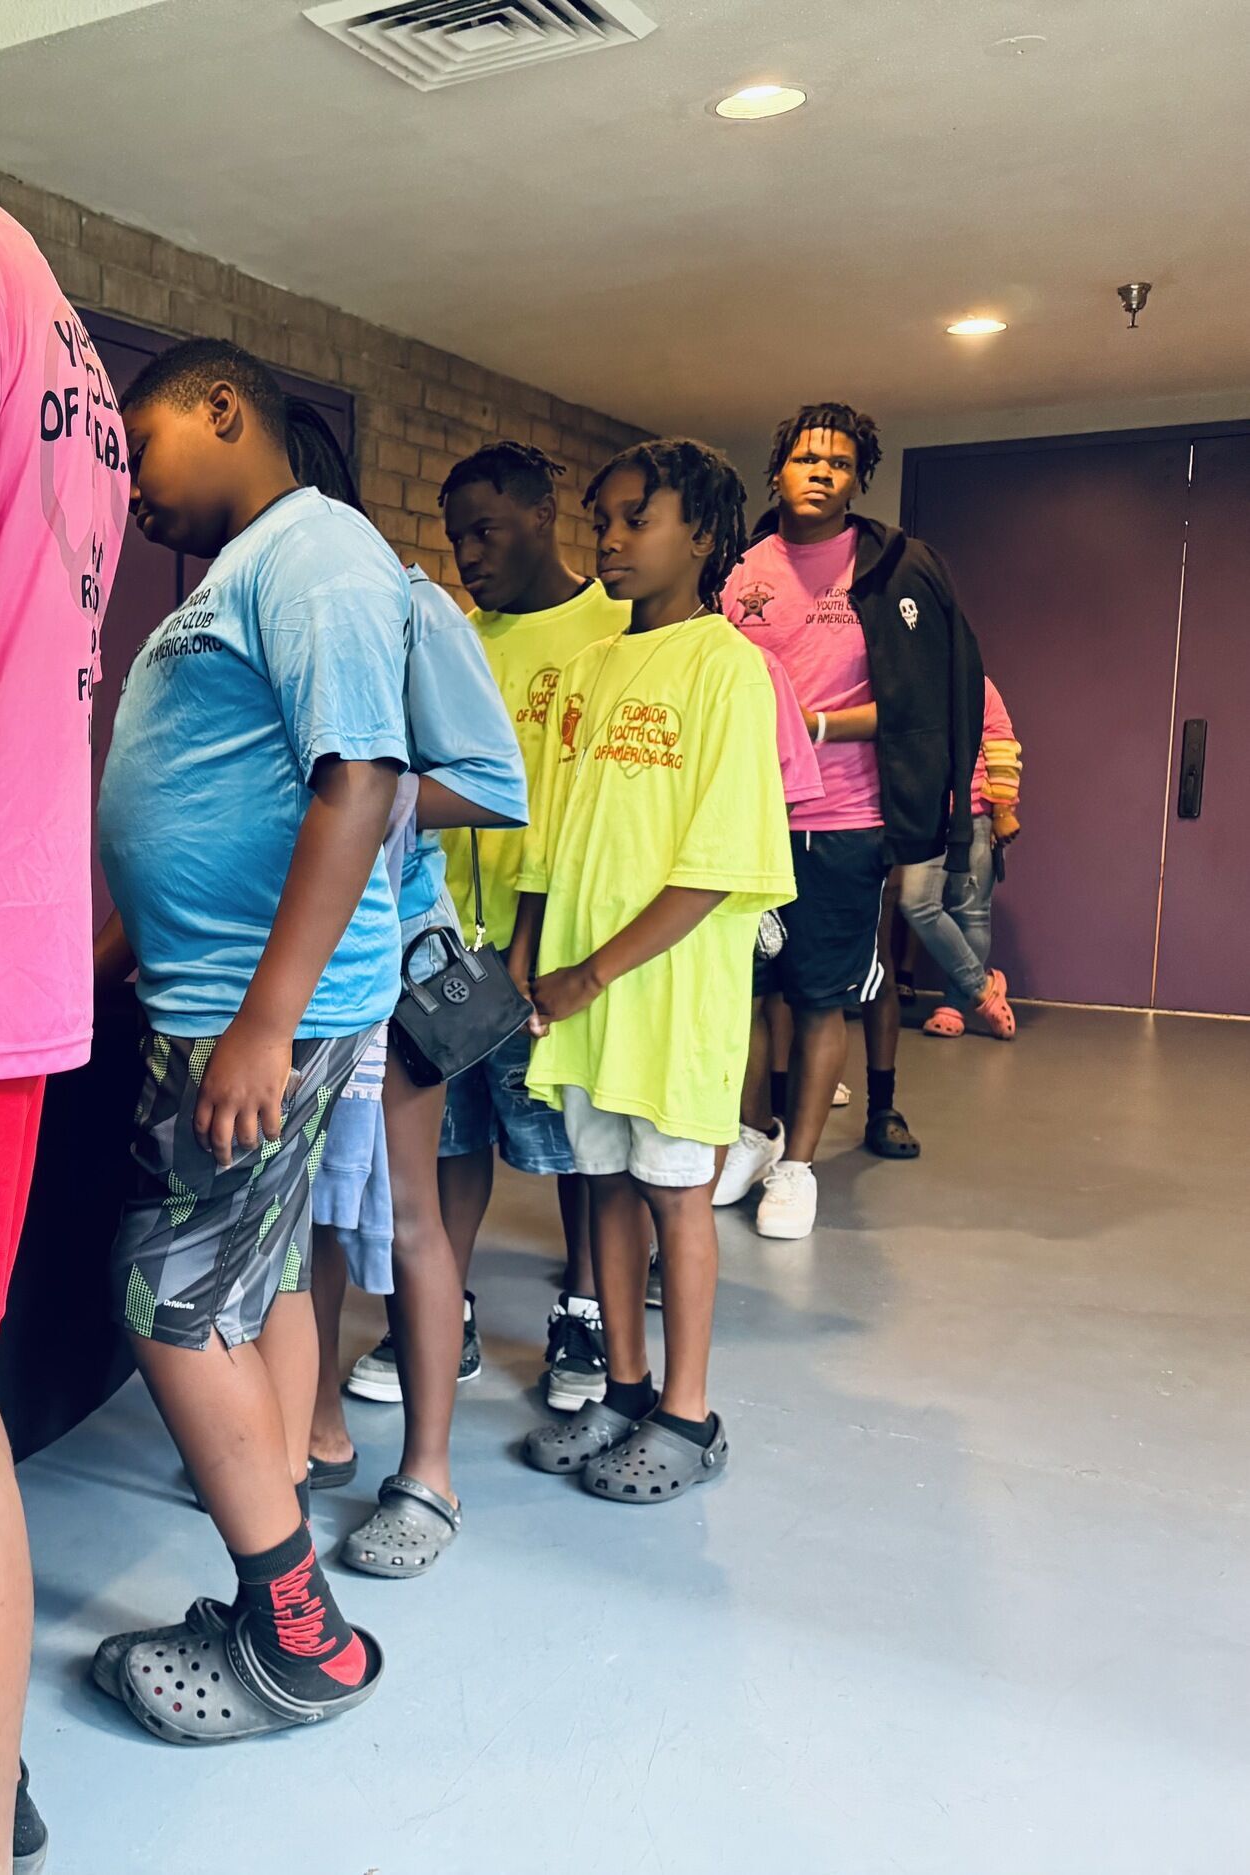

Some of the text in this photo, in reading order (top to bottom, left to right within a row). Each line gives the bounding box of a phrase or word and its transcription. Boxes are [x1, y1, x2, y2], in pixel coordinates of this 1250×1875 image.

[817, 600, 844, 611] YOUTH
[182, 611, 215, 630] CLUB
[805, 614, 816, 624] OF
[621, 705, 667, 725] FLORIDA
[610, 724, 677, 747] YOUTH CLUB
